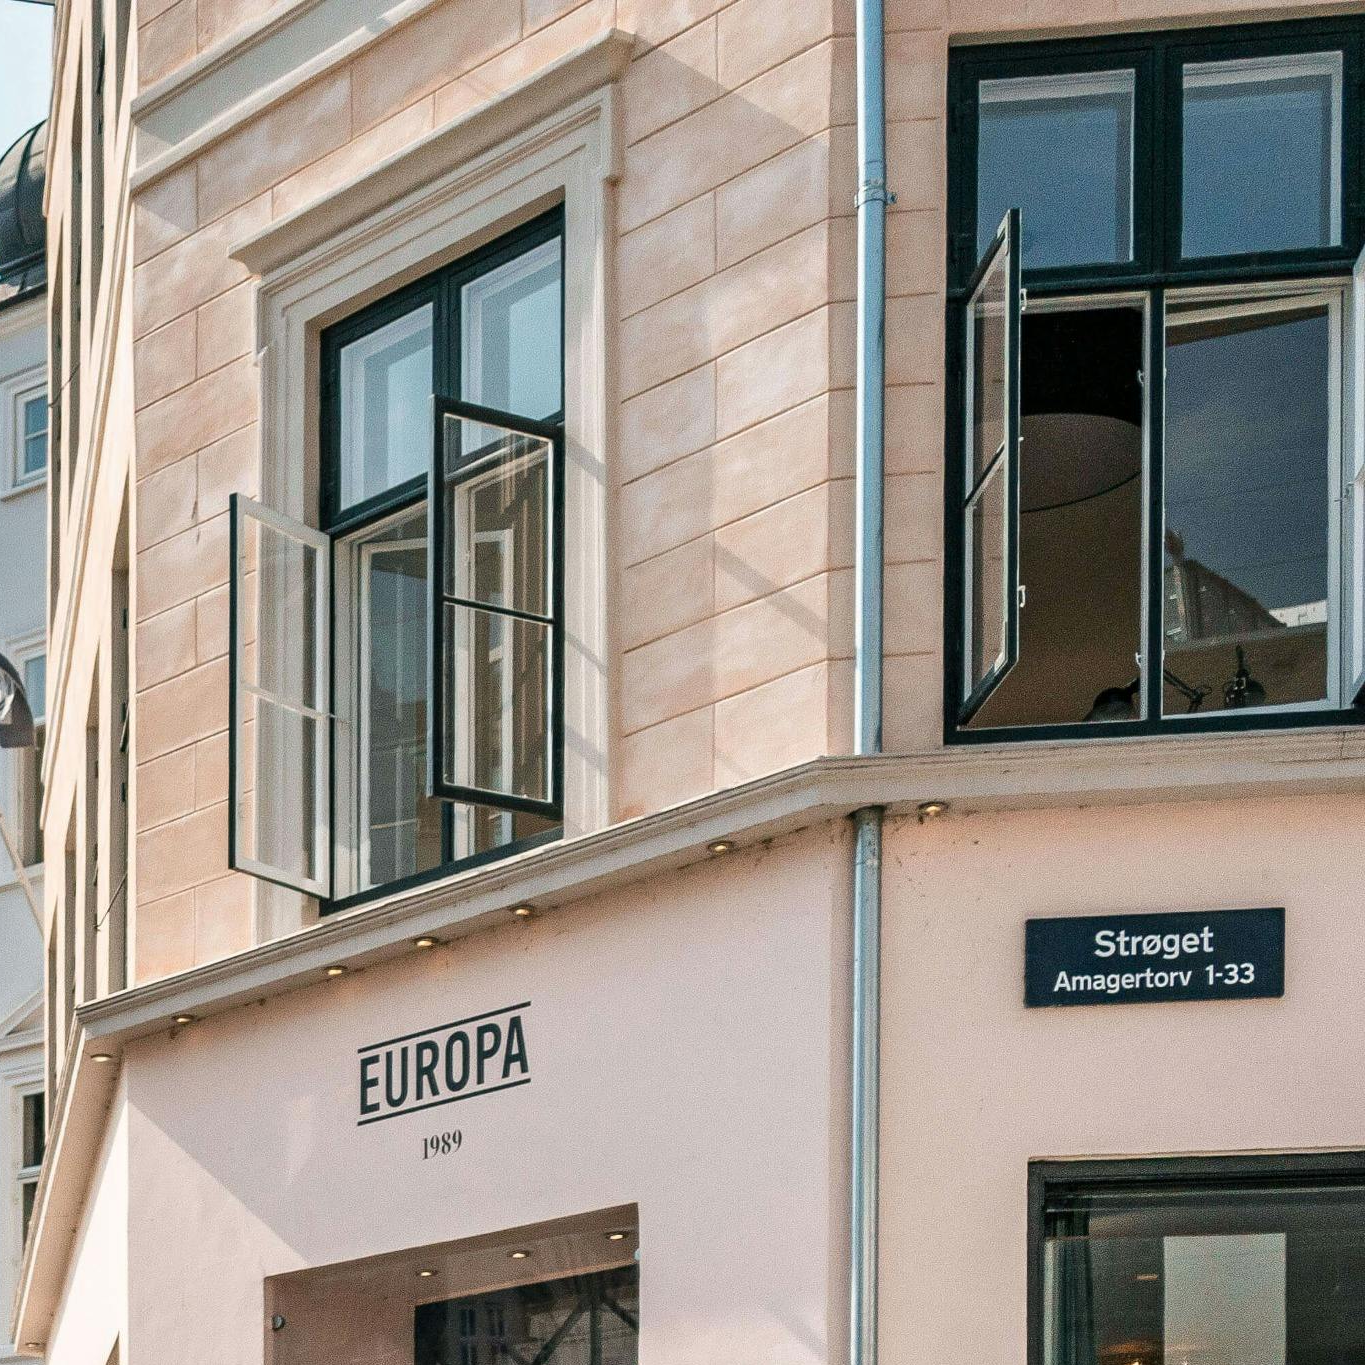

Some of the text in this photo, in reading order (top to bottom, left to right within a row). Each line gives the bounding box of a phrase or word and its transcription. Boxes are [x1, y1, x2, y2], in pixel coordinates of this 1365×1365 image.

[1094, 926, 1214, 959] Strøget
[1053, 962, 1255, 993] Amagertorv 1-33
[360, 1015, 529, 1115] EUROPA
[422, 1129, 463, 1160] 1989
